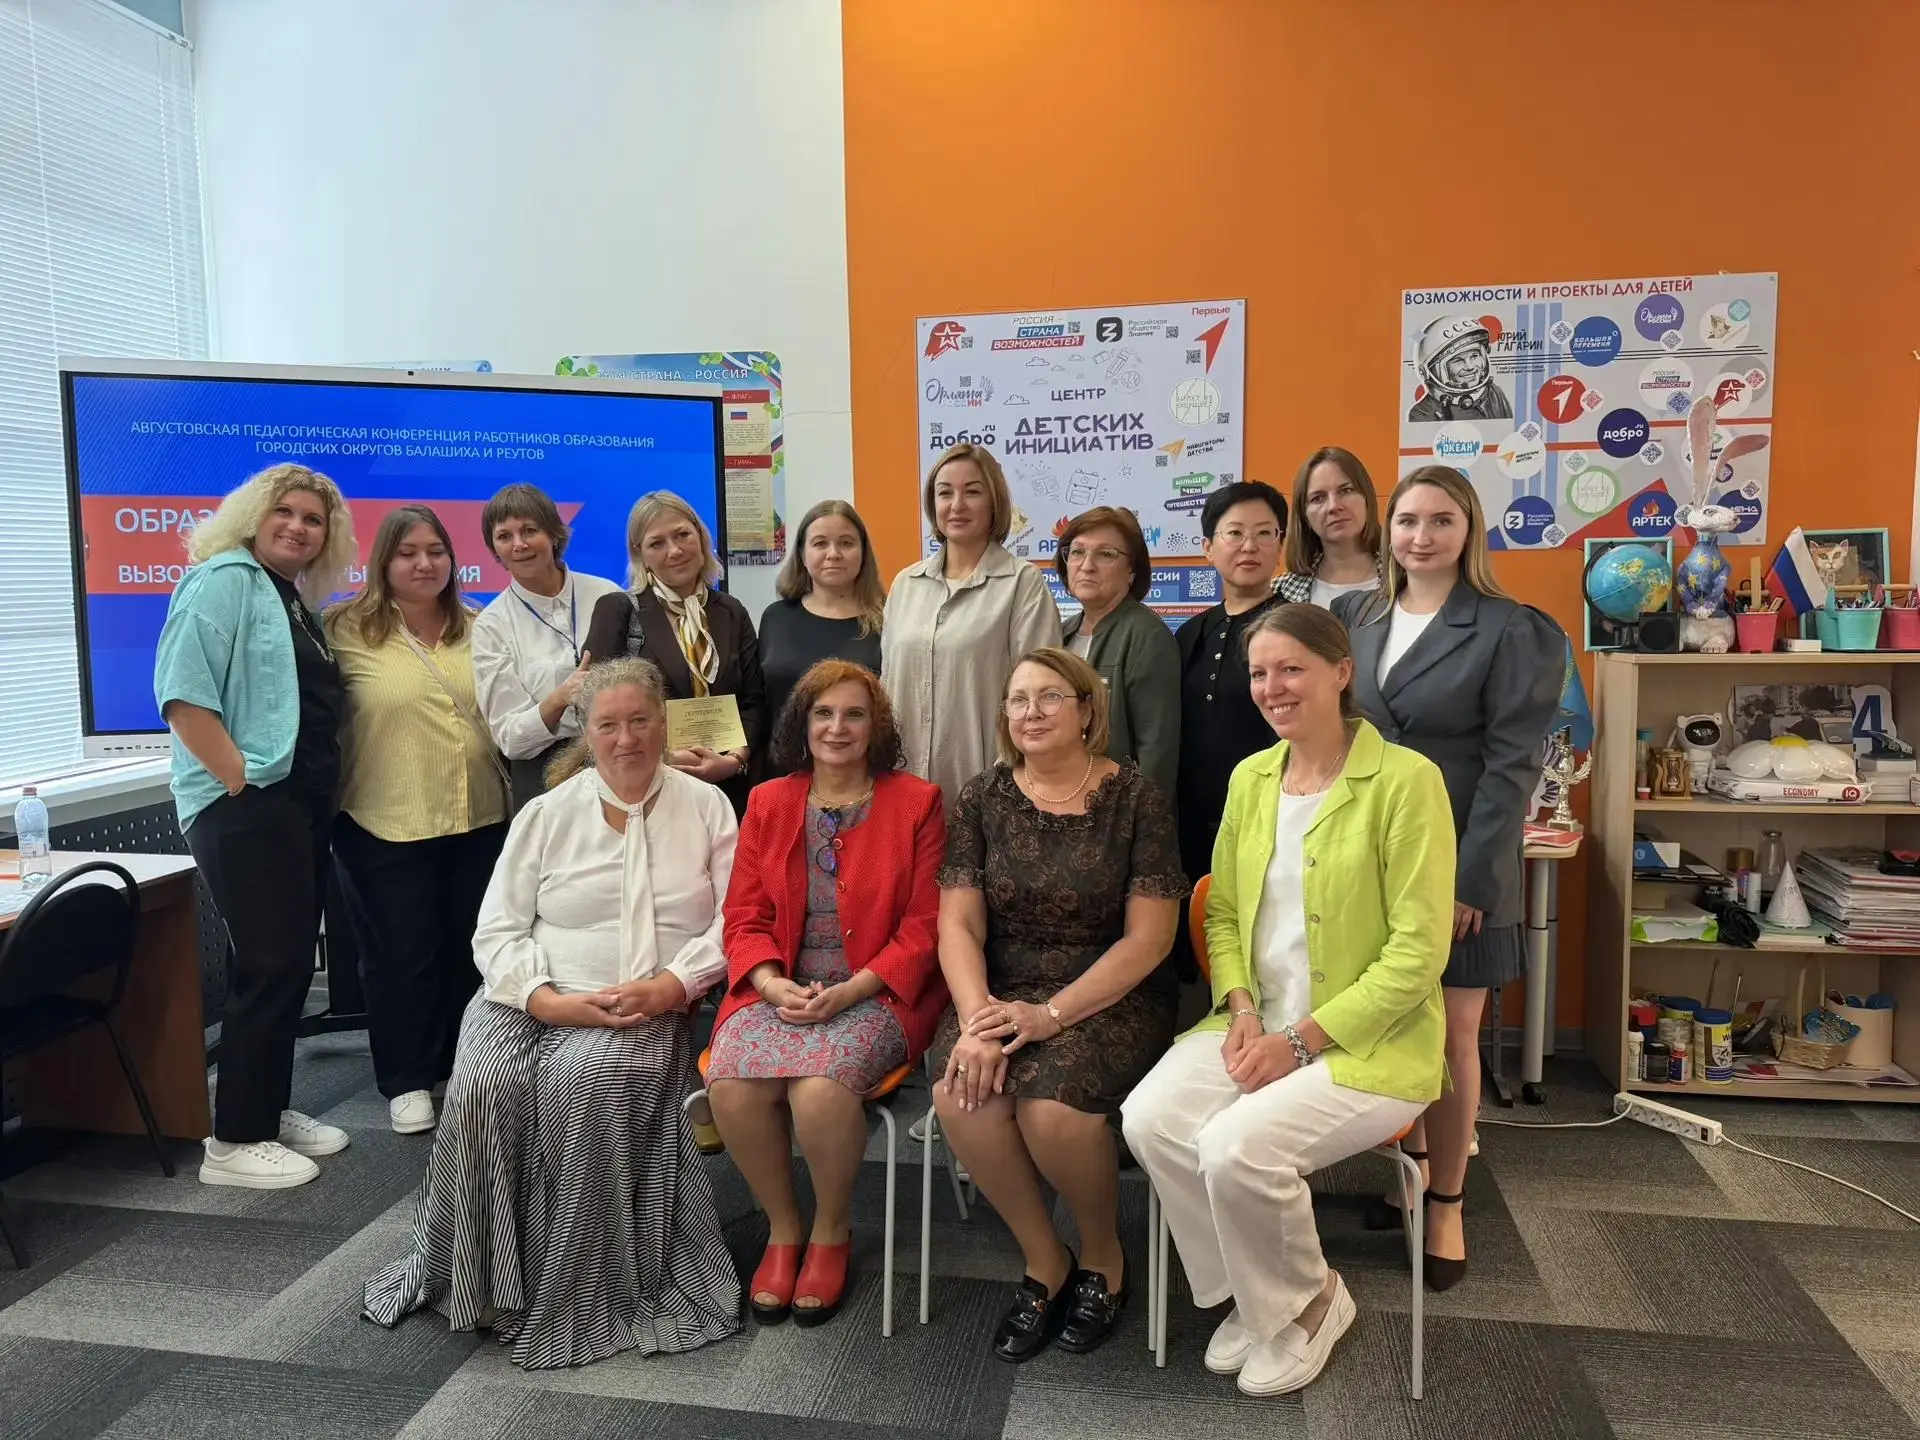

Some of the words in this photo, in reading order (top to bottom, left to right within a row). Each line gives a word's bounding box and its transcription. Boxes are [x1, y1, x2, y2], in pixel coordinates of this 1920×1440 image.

[1404, 288, 1522, 306] ВОЗМОЖНОСТИ
[1527, 286, 1536, 299] И
[1541, 284, 1608, 298] ПРОЕКТЫ
[1613, 282, 1644, 296] ДЛЯ
[1647, 277, 1693, 294] ДЕТЕЙ
[1191, 306, 1231, 317] Первые
[1012, 315, 1054, 325] РОССИЯ
[1019, 326, 1060, 337] СТРАНА
[1497, 329, 1527, 342] ЮРИЙ
[993, 337, 1080, 350] ВОЗМОЖНОСТЕЙ
[1496, 340, 1543, 352] ГАГАРИН
[631, 370, 682, 380] СТРАНА
[695, 369, 748, 380] РОССИЯ
[1051, 388, 1107, 402] ЦЕНТР
[1014, 412, 1145, 436] ДЕТСКИХ
[130, 421, 240, 436] АВГУСТОВСКАЯ
[243, 424, 368, 439] ПЕДАГОГИЧЕСКАЯ
[371, 428, 471, 443] КОНФЕРЕНЦИЯ
[474, 431, 561, 445] РАБОТНИКОВ
[563, 434, 655, 448] ОБРАЗОВАНИЯ
[1602, 426, 1644, 439] добро
[930, 430, 996, 450] добро
[1005, 433, 1154, 456] ИНИЦИАТИВ
[1186, 437, 1226, 451] НАВИГАТОРЫ
[255, 441, 339, 455] ГОРОДСКИХ
[341, 443, 402, 457] ОКРУГОВ
[405, 445, 480, 459] БАЛАШИХА
[483, 448, 493, 459] И
[496, 448, 545, 460] РЕУТОВ
[1443, 443, 1473, 452] ОКЕАН
[1166, 497, 1208, 508] ПУТЕШЕСТВ
[1632, 515, 1672, 527] АРТЕК
[1150, 572, 1180, 582] ССИИ
[1852, 694, 1888, 755] 4
[1783, 786, 1820, 798] ECONOMY
[1844, 788, 1859, 799] IQ
